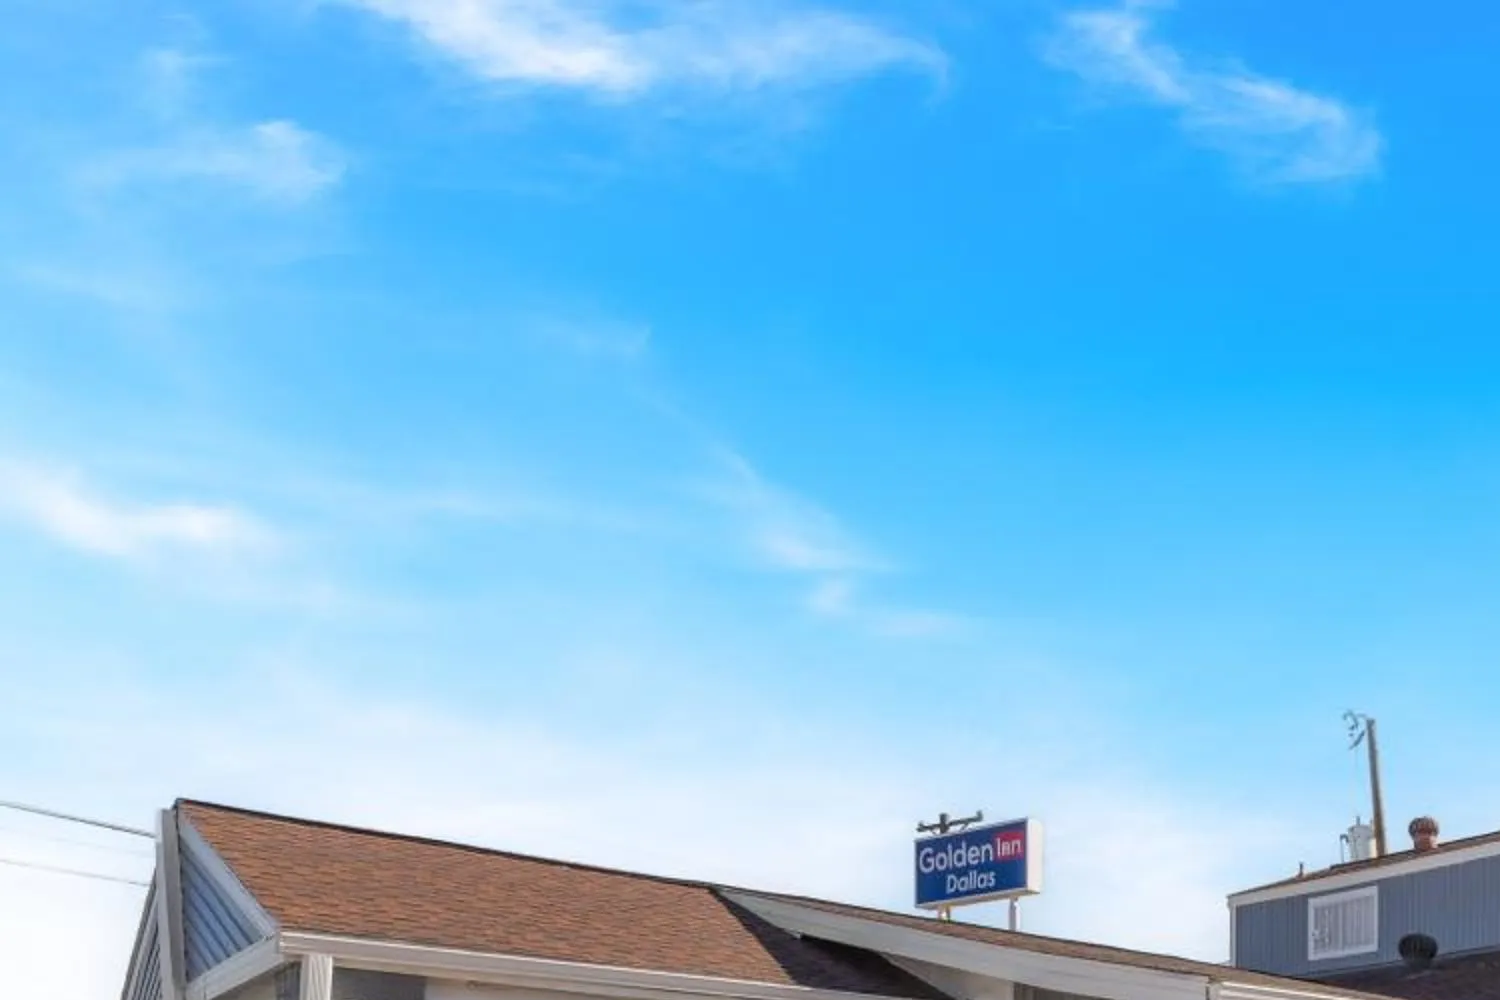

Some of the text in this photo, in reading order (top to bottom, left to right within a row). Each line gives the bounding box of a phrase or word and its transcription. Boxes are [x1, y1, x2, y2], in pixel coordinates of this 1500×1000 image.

[919, 837, 1022, 874] Golden Inn
[945, 870, 996, 894] Dallas
